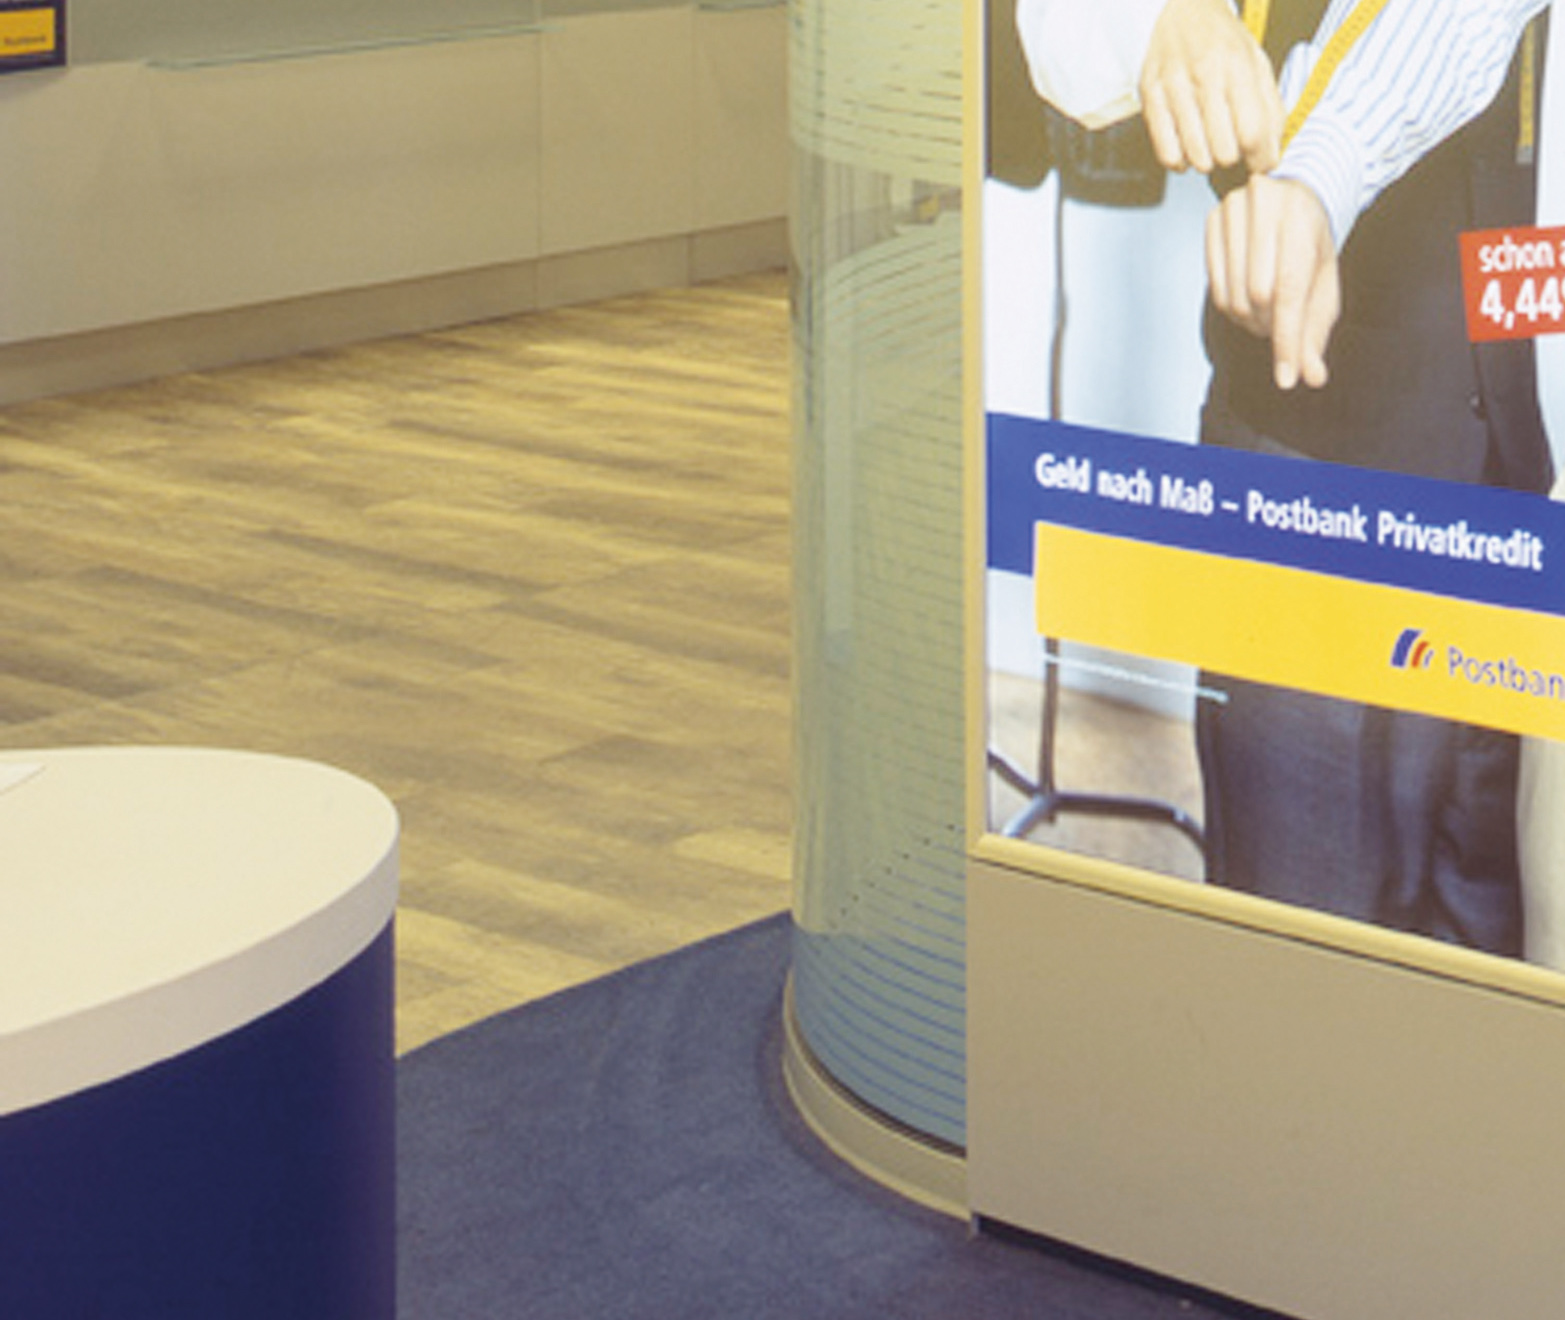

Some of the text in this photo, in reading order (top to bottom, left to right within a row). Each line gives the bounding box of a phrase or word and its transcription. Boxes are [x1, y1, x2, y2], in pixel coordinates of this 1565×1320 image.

[1478, 234, 1555, 273] schon
[1035, 452, 1090, 493] Geld
[1096, 467, 1153, 506] nach
[1159, 474, 1214, 516] Maß
[1246, 488, 1368, 543] Postbank
[1377, 509, 1544, 571] Privatkredit
